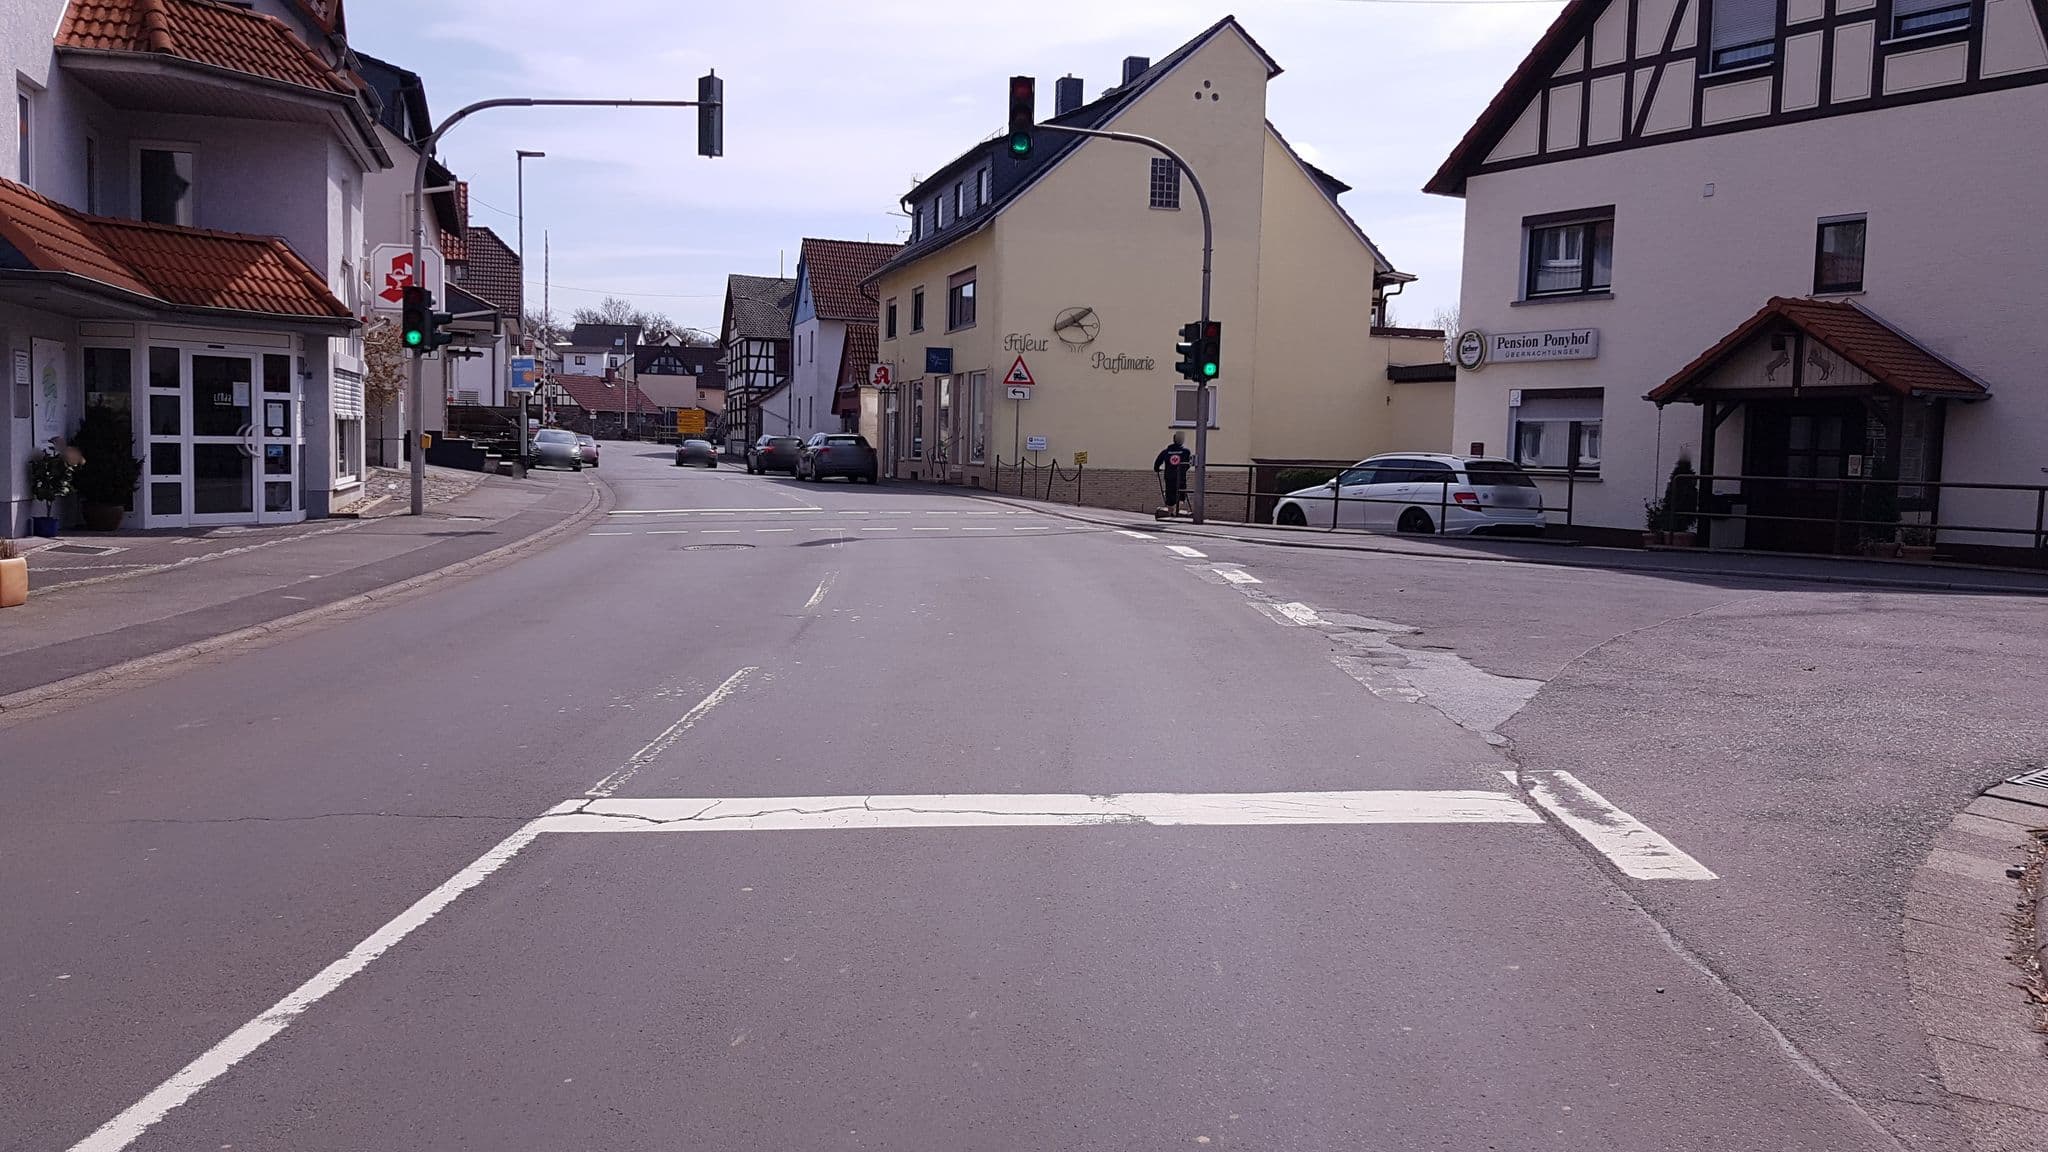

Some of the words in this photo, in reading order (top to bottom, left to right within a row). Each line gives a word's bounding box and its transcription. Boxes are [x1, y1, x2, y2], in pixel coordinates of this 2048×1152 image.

[1497, 335, 1538, 349] Pension
[1544, 331, 1591, 347] Ponyhof
[1505, 348, 1580, 358] ÜBERNACHTUNGEN
[1092, 351, 1155, 374] Parfümerie
